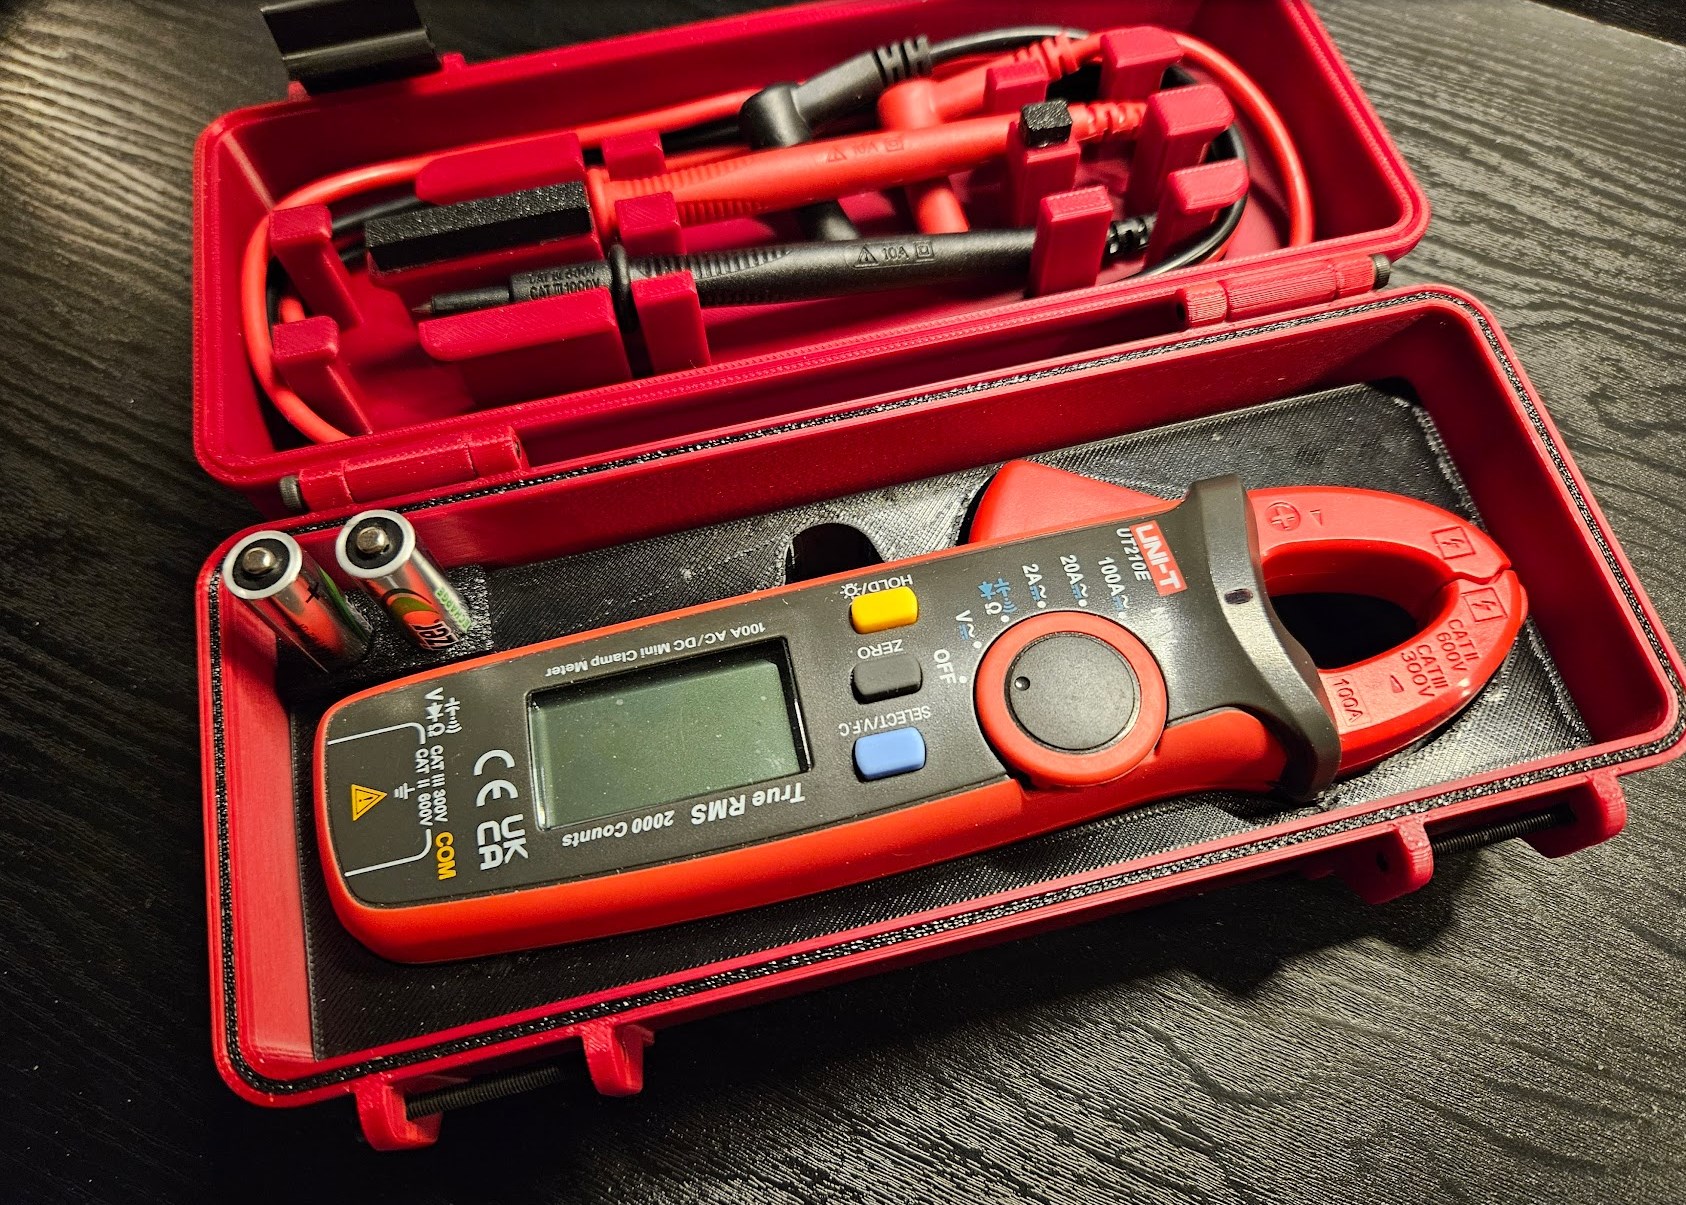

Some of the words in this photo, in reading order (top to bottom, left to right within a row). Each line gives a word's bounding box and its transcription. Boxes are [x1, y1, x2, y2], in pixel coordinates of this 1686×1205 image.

[883, 245, 910, 261] 10A
[529, 283, 551, 299] CAT
[564, 277, 600, 294] 1000V
[1116, 527, 1152, 581] UT210E
[1135, 524, 1182, 590] UNI-T
[1021, 563, 1043, 585] 2A
[1060, 554, 1084, 585] 20A
[1098, 556, 1126, 596] 100A
[435, 587, 471, 633] ECHARGE
[674, 629, 727, 651] AC/DC
[731, 622, 767, 638] 100A
[590, 650, 638, 668] Clamp
[640, 642, 671, 658] Mini
[857, 639, 904, 660] ZERO
[1436, 632, 1467, 671] 600V
[545, 660, 588, 677] Meter
[933, 649, 957, 685] OFF
[1401, 651, 1435, 697] 300V
[1333, 678, 1363, 723] 100A
[415, 748, 430, 774] CAT
[430, 745, 444, 771] CAT
[416, 778, 430, 789] II
[432, 773, 446, 788] III
[473, 749, 519, 807] CE
[433, 789, 448, 823] 300V
[752, 782, 806, 807] True
[418, 792, 433, 826] 600V
[631, 810, 675, 834] 2000
[691, 795, 746, 825] RMS
[477, 820, 504, 871] CA
[501, 813, 529, 864] UK
[562, 822, 628, 848] Counts
[435, 831, 457, 880] COM
